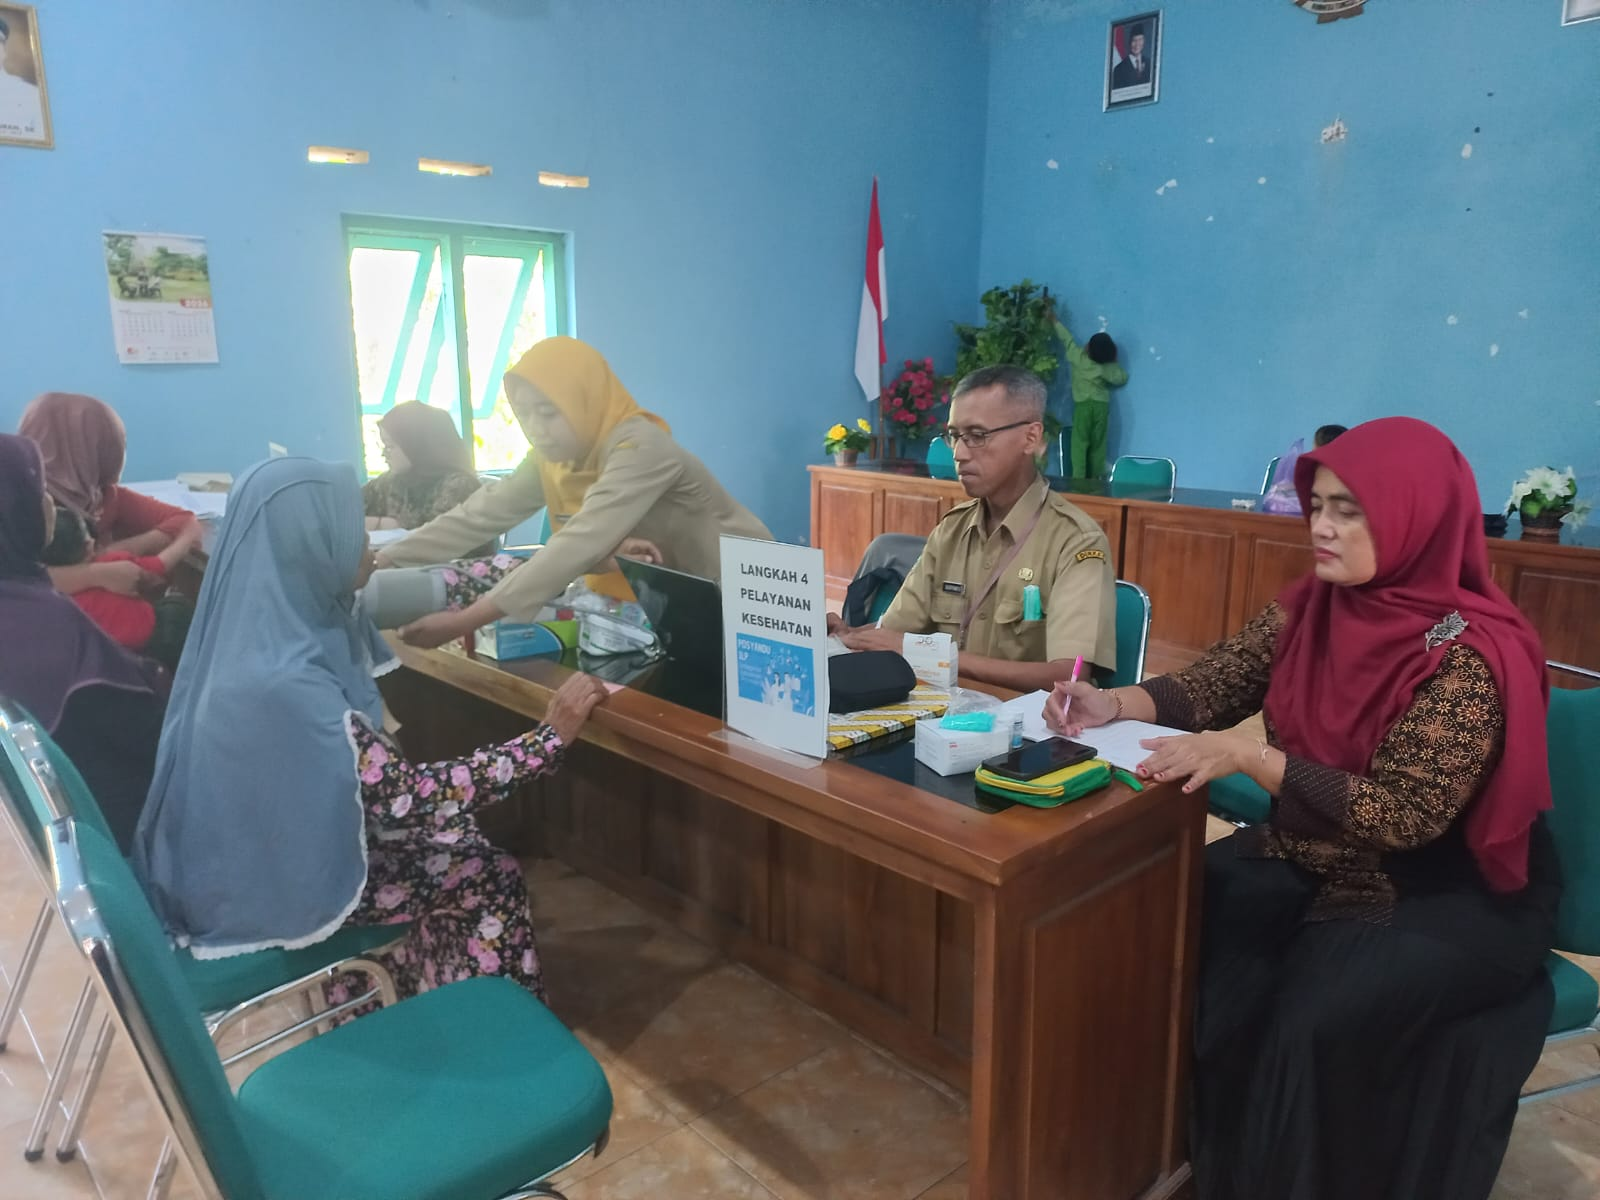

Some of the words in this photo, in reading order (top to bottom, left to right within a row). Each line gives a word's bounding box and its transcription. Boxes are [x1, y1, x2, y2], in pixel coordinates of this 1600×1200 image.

[740, 563, 797, 583] LANGKAH
[801, 573, 809, 585] 4
[740, 587, 811, 611] PELAYANAN
[741, 612, 812, 638] KESEHATAN
